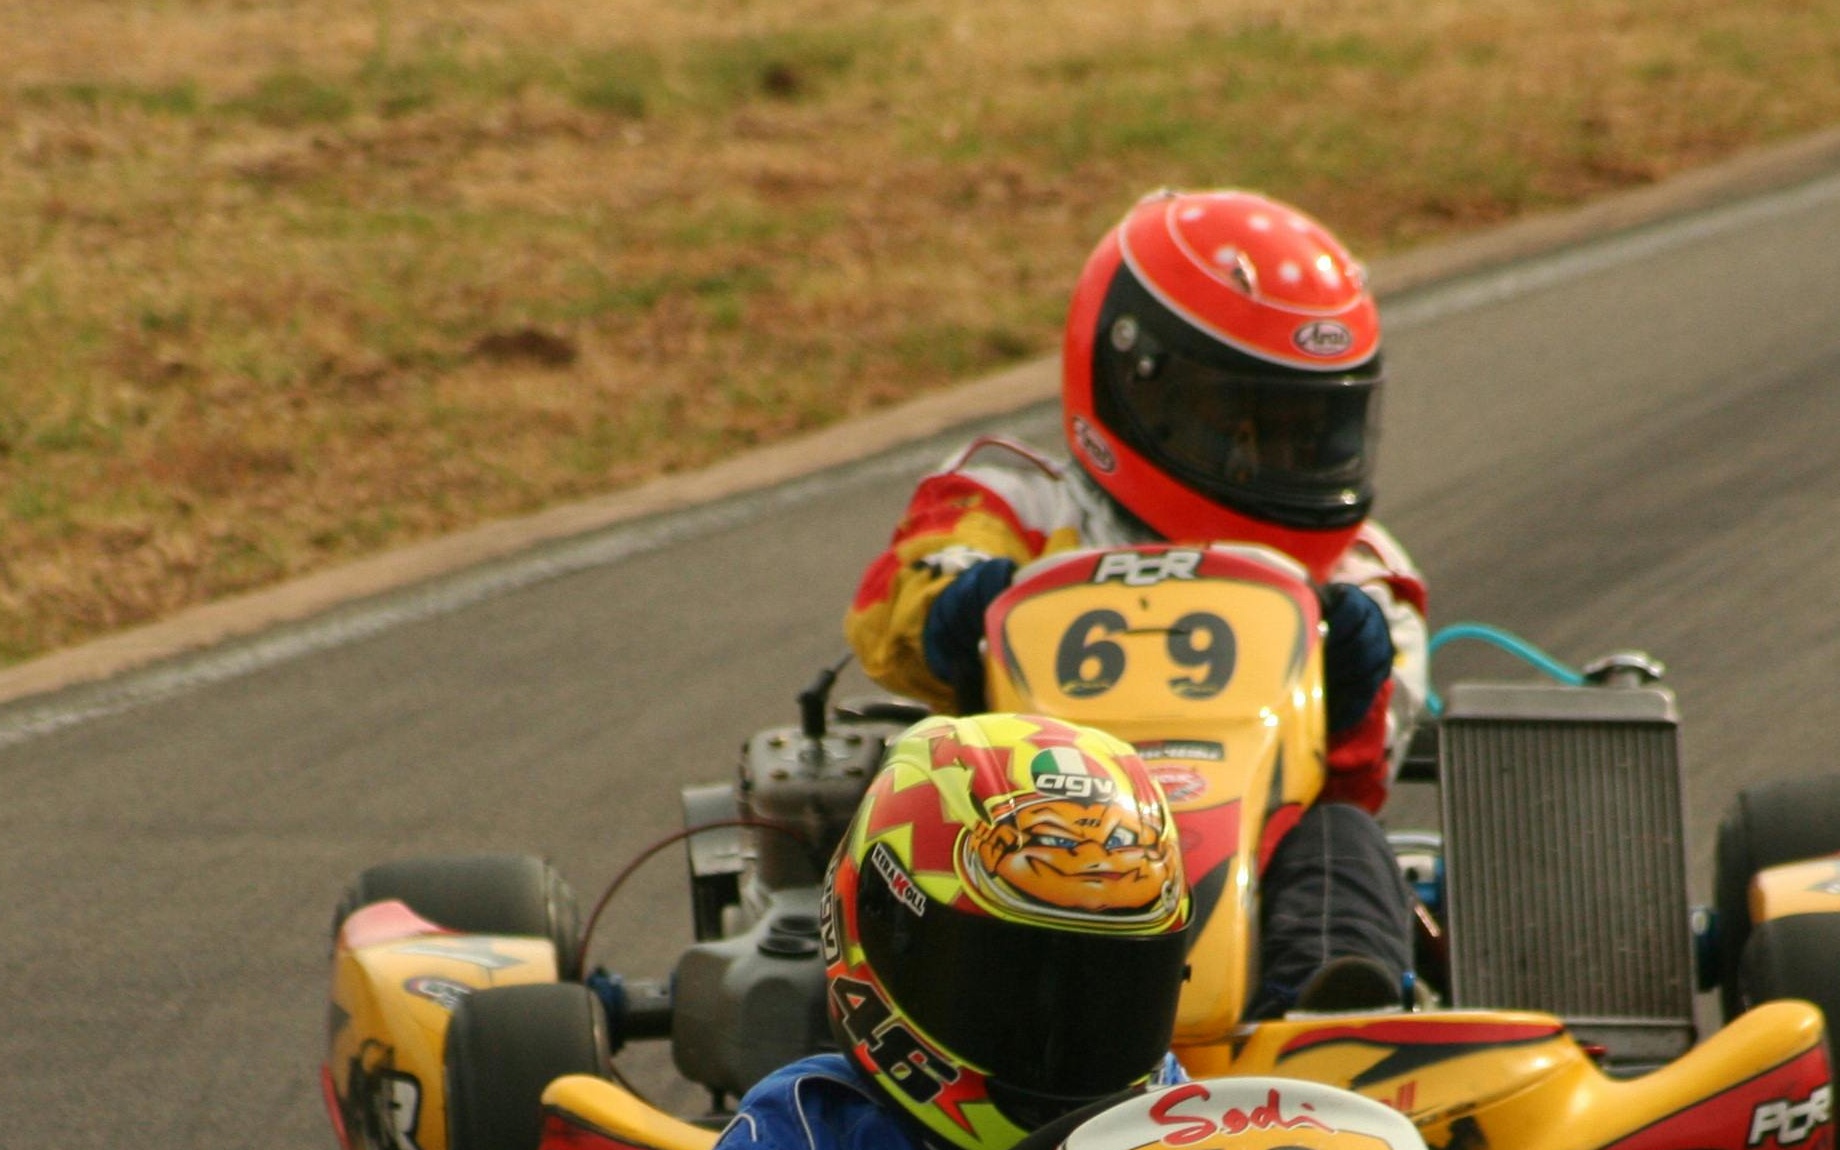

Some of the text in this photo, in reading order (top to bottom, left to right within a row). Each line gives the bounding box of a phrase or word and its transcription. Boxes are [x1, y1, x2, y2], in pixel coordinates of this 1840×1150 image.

[1094, 551, 1202, 585] PCR
[830, 976, 960, 1104] 46
[1150, 1084, 1337, 1146] Sodi
[1747, 1084, 1831, 1145] PCR
